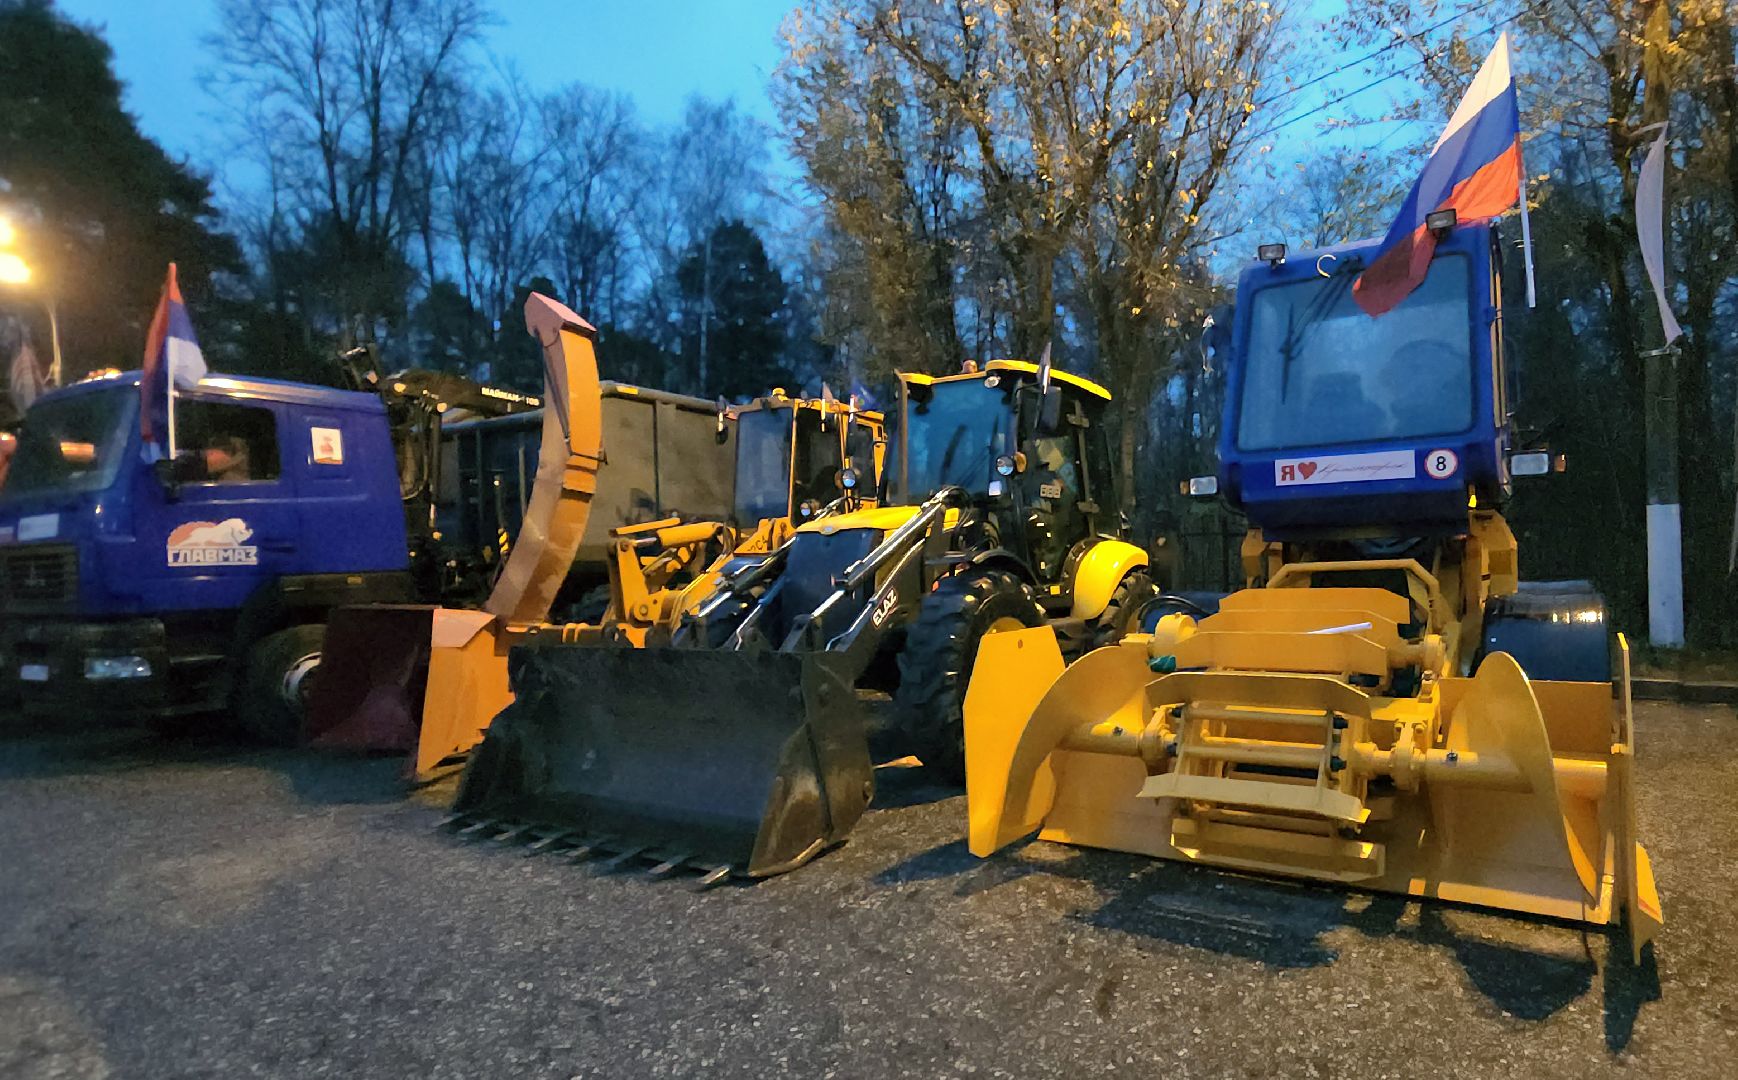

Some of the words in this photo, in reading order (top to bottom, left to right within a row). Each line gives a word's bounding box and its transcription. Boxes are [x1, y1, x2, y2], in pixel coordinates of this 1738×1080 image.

[1436, 456, 1447, 471] 8
[1281, 464, 1295, 481] Я
[167, 547, 257, 565] ГЛАВМАЗ
[873, 589, 897, 626] ELAZ
